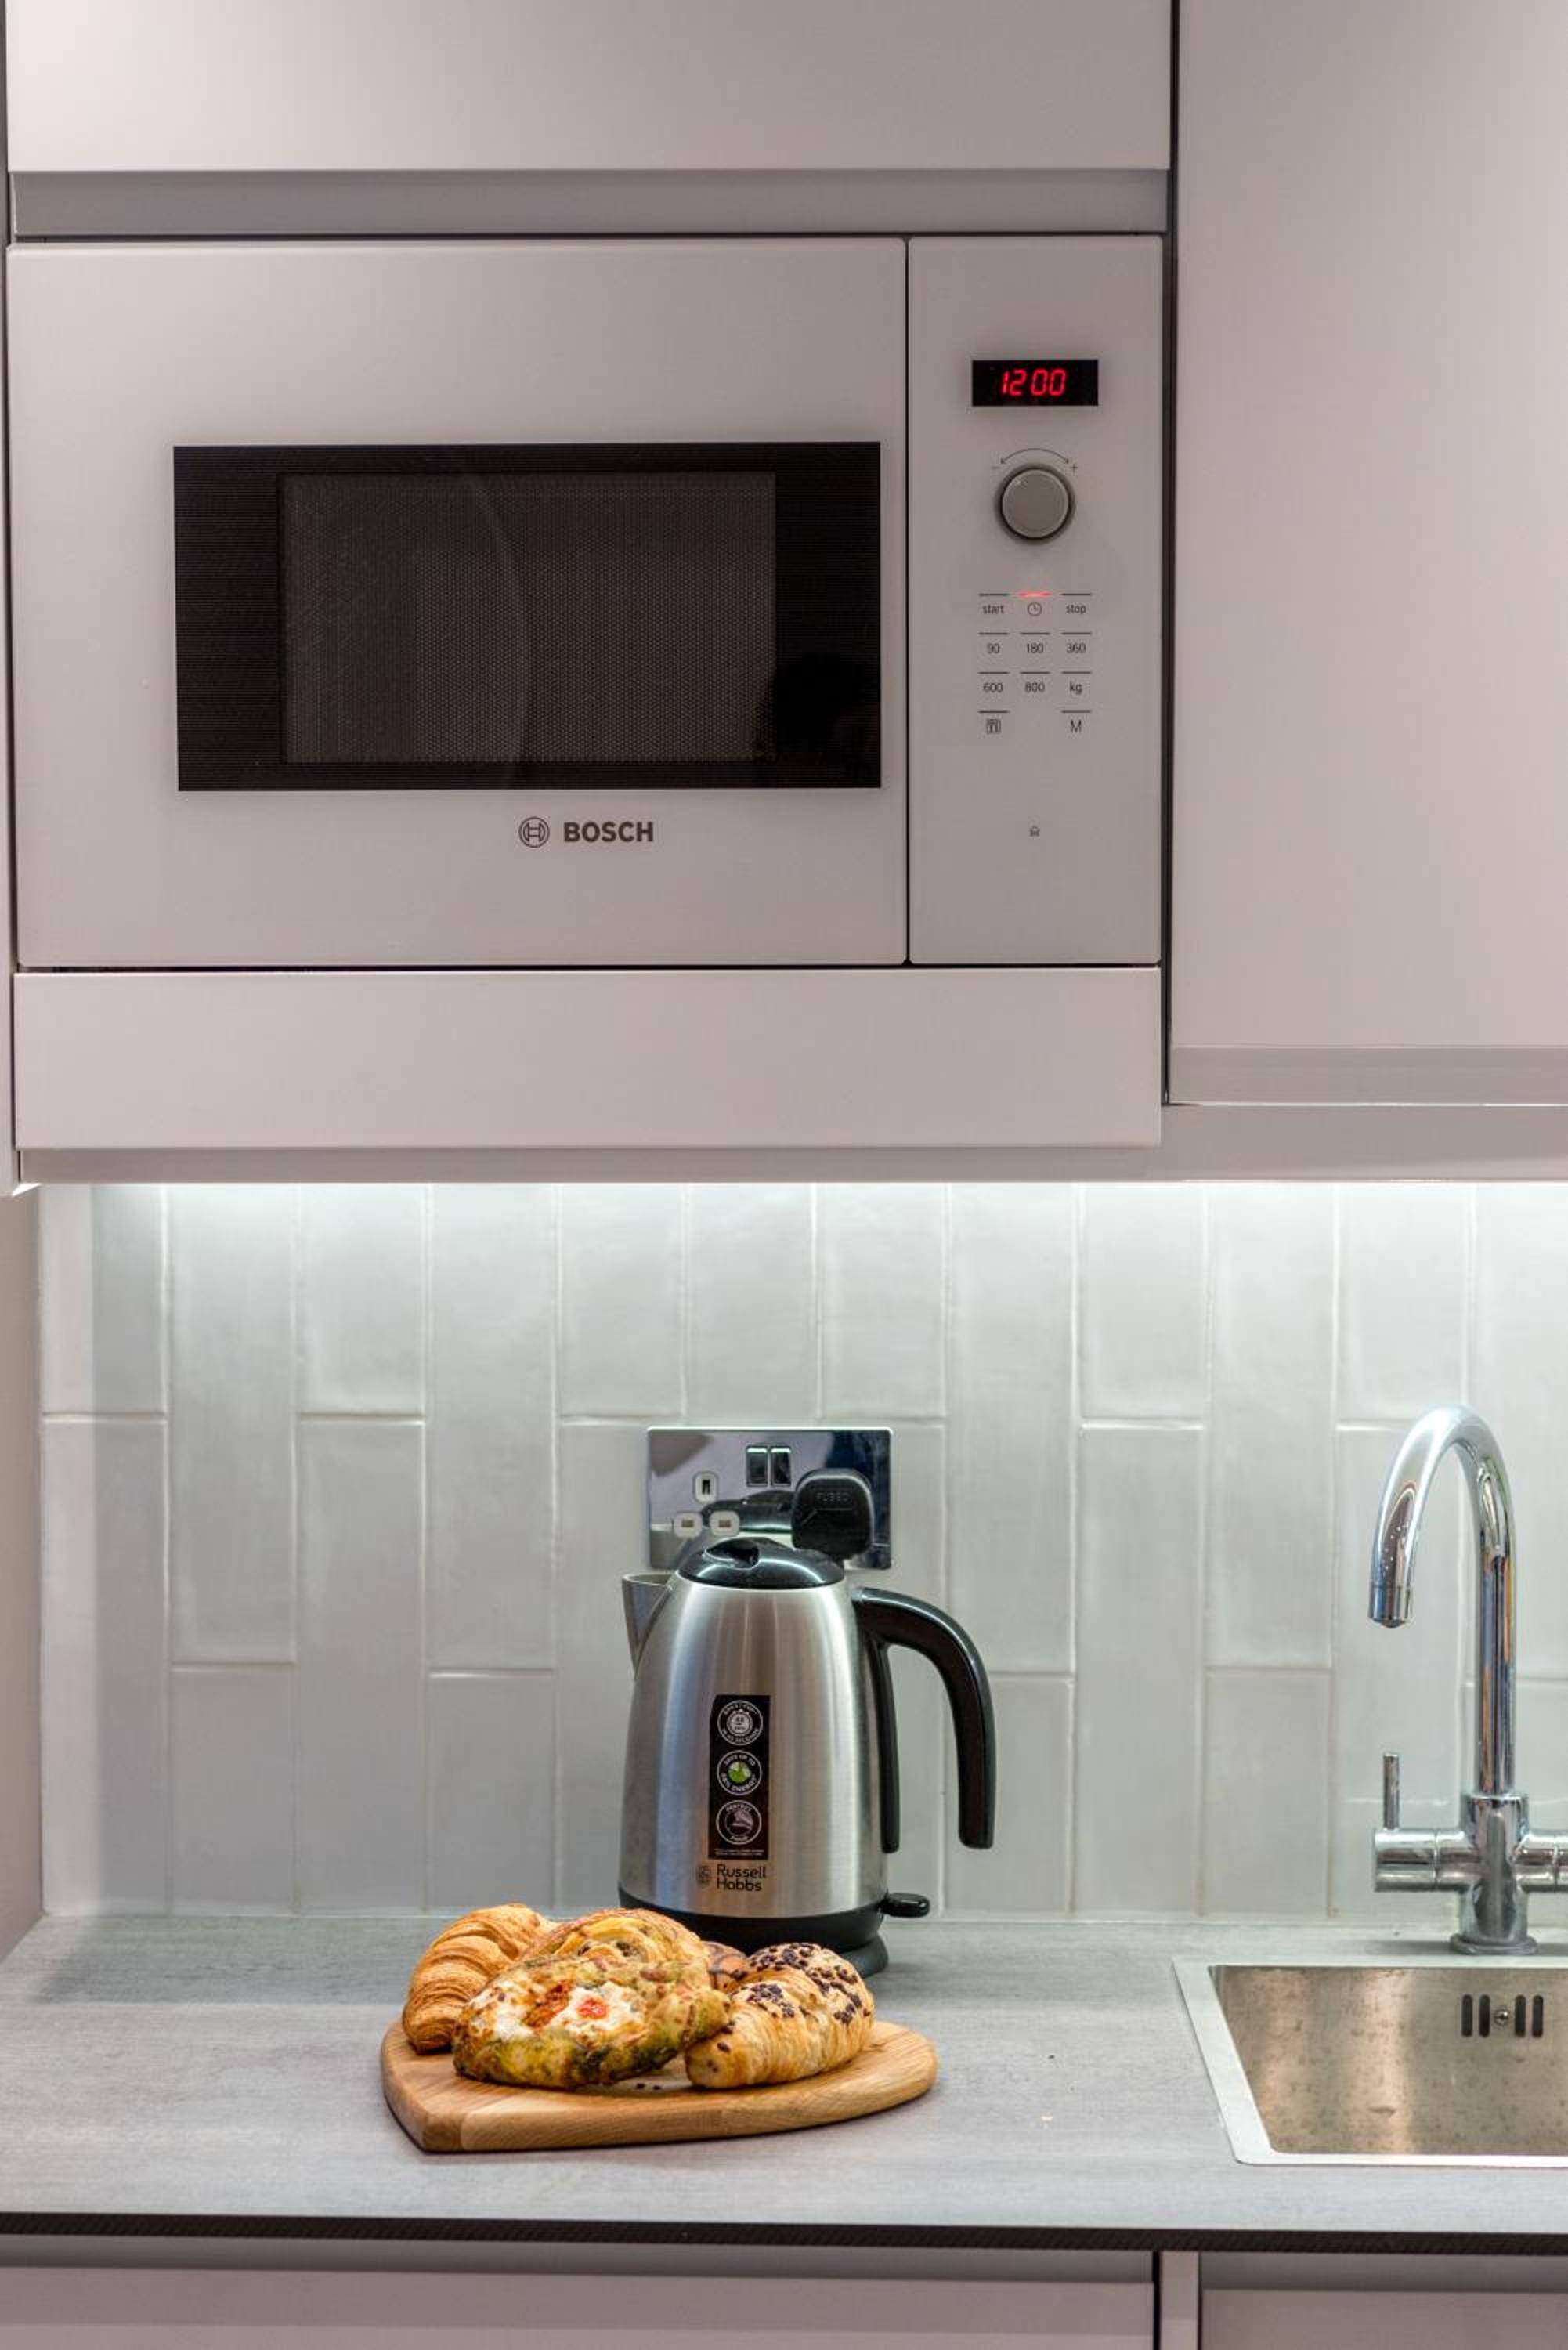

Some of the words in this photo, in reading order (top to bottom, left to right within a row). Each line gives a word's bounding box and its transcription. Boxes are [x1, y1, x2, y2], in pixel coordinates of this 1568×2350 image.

[982, 604, 1005, 615] start
[1065, 604, 1087, 615] stop
[986, 642, 1001, 655] 90
[1026, 642, 1044, 654] 180
[1066, 642, 1086, 654] 360
[983, 682, 1003, 693] 600
[1024, 682, 1046, 693] 800
[1069, 681, 1083, 696] kg
[1069, 719, 1082, 733] M
[563, 821, 654, 843] BOSCH
[717, 1863, 767, 1878] Russell
[717, 1878, 763, 1892] Hobbs
